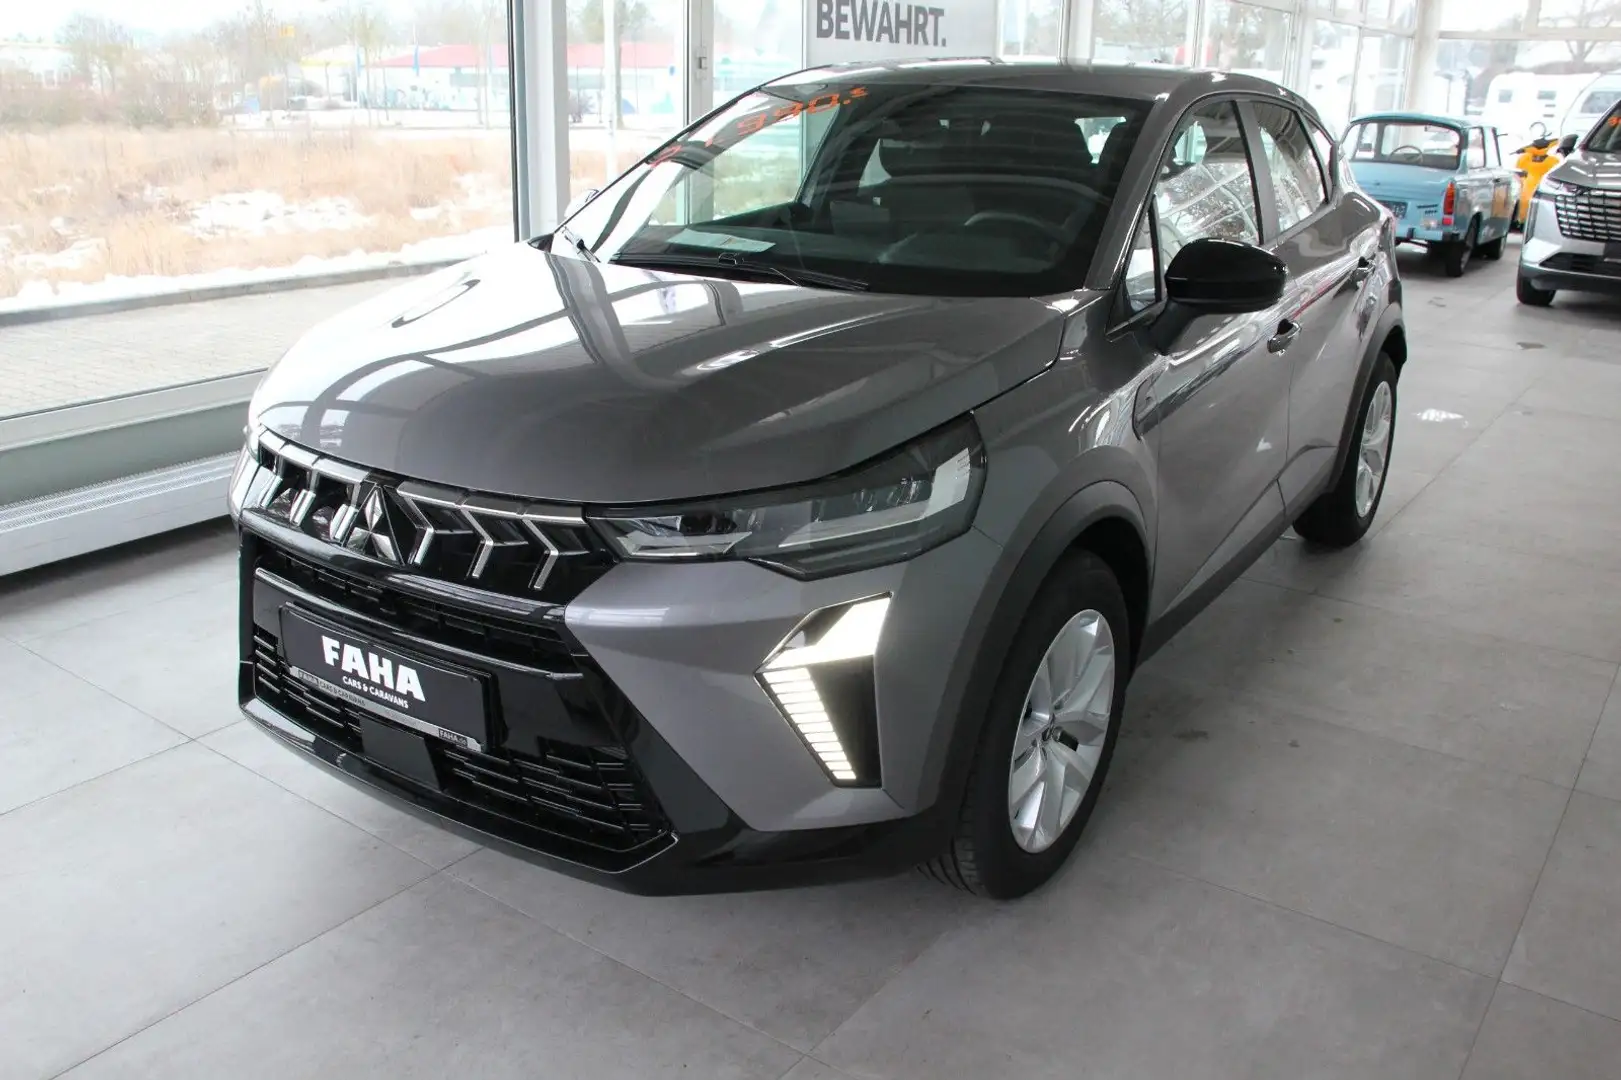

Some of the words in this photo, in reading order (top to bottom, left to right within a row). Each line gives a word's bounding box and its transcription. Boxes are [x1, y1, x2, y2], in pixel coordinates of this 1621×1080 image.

[321, 635, 426, 702] FAHA
[342, 675, 362, 690] CARS
[362, 683, 369, 692] &
[369, 686, 409, 709] CARAVANS
